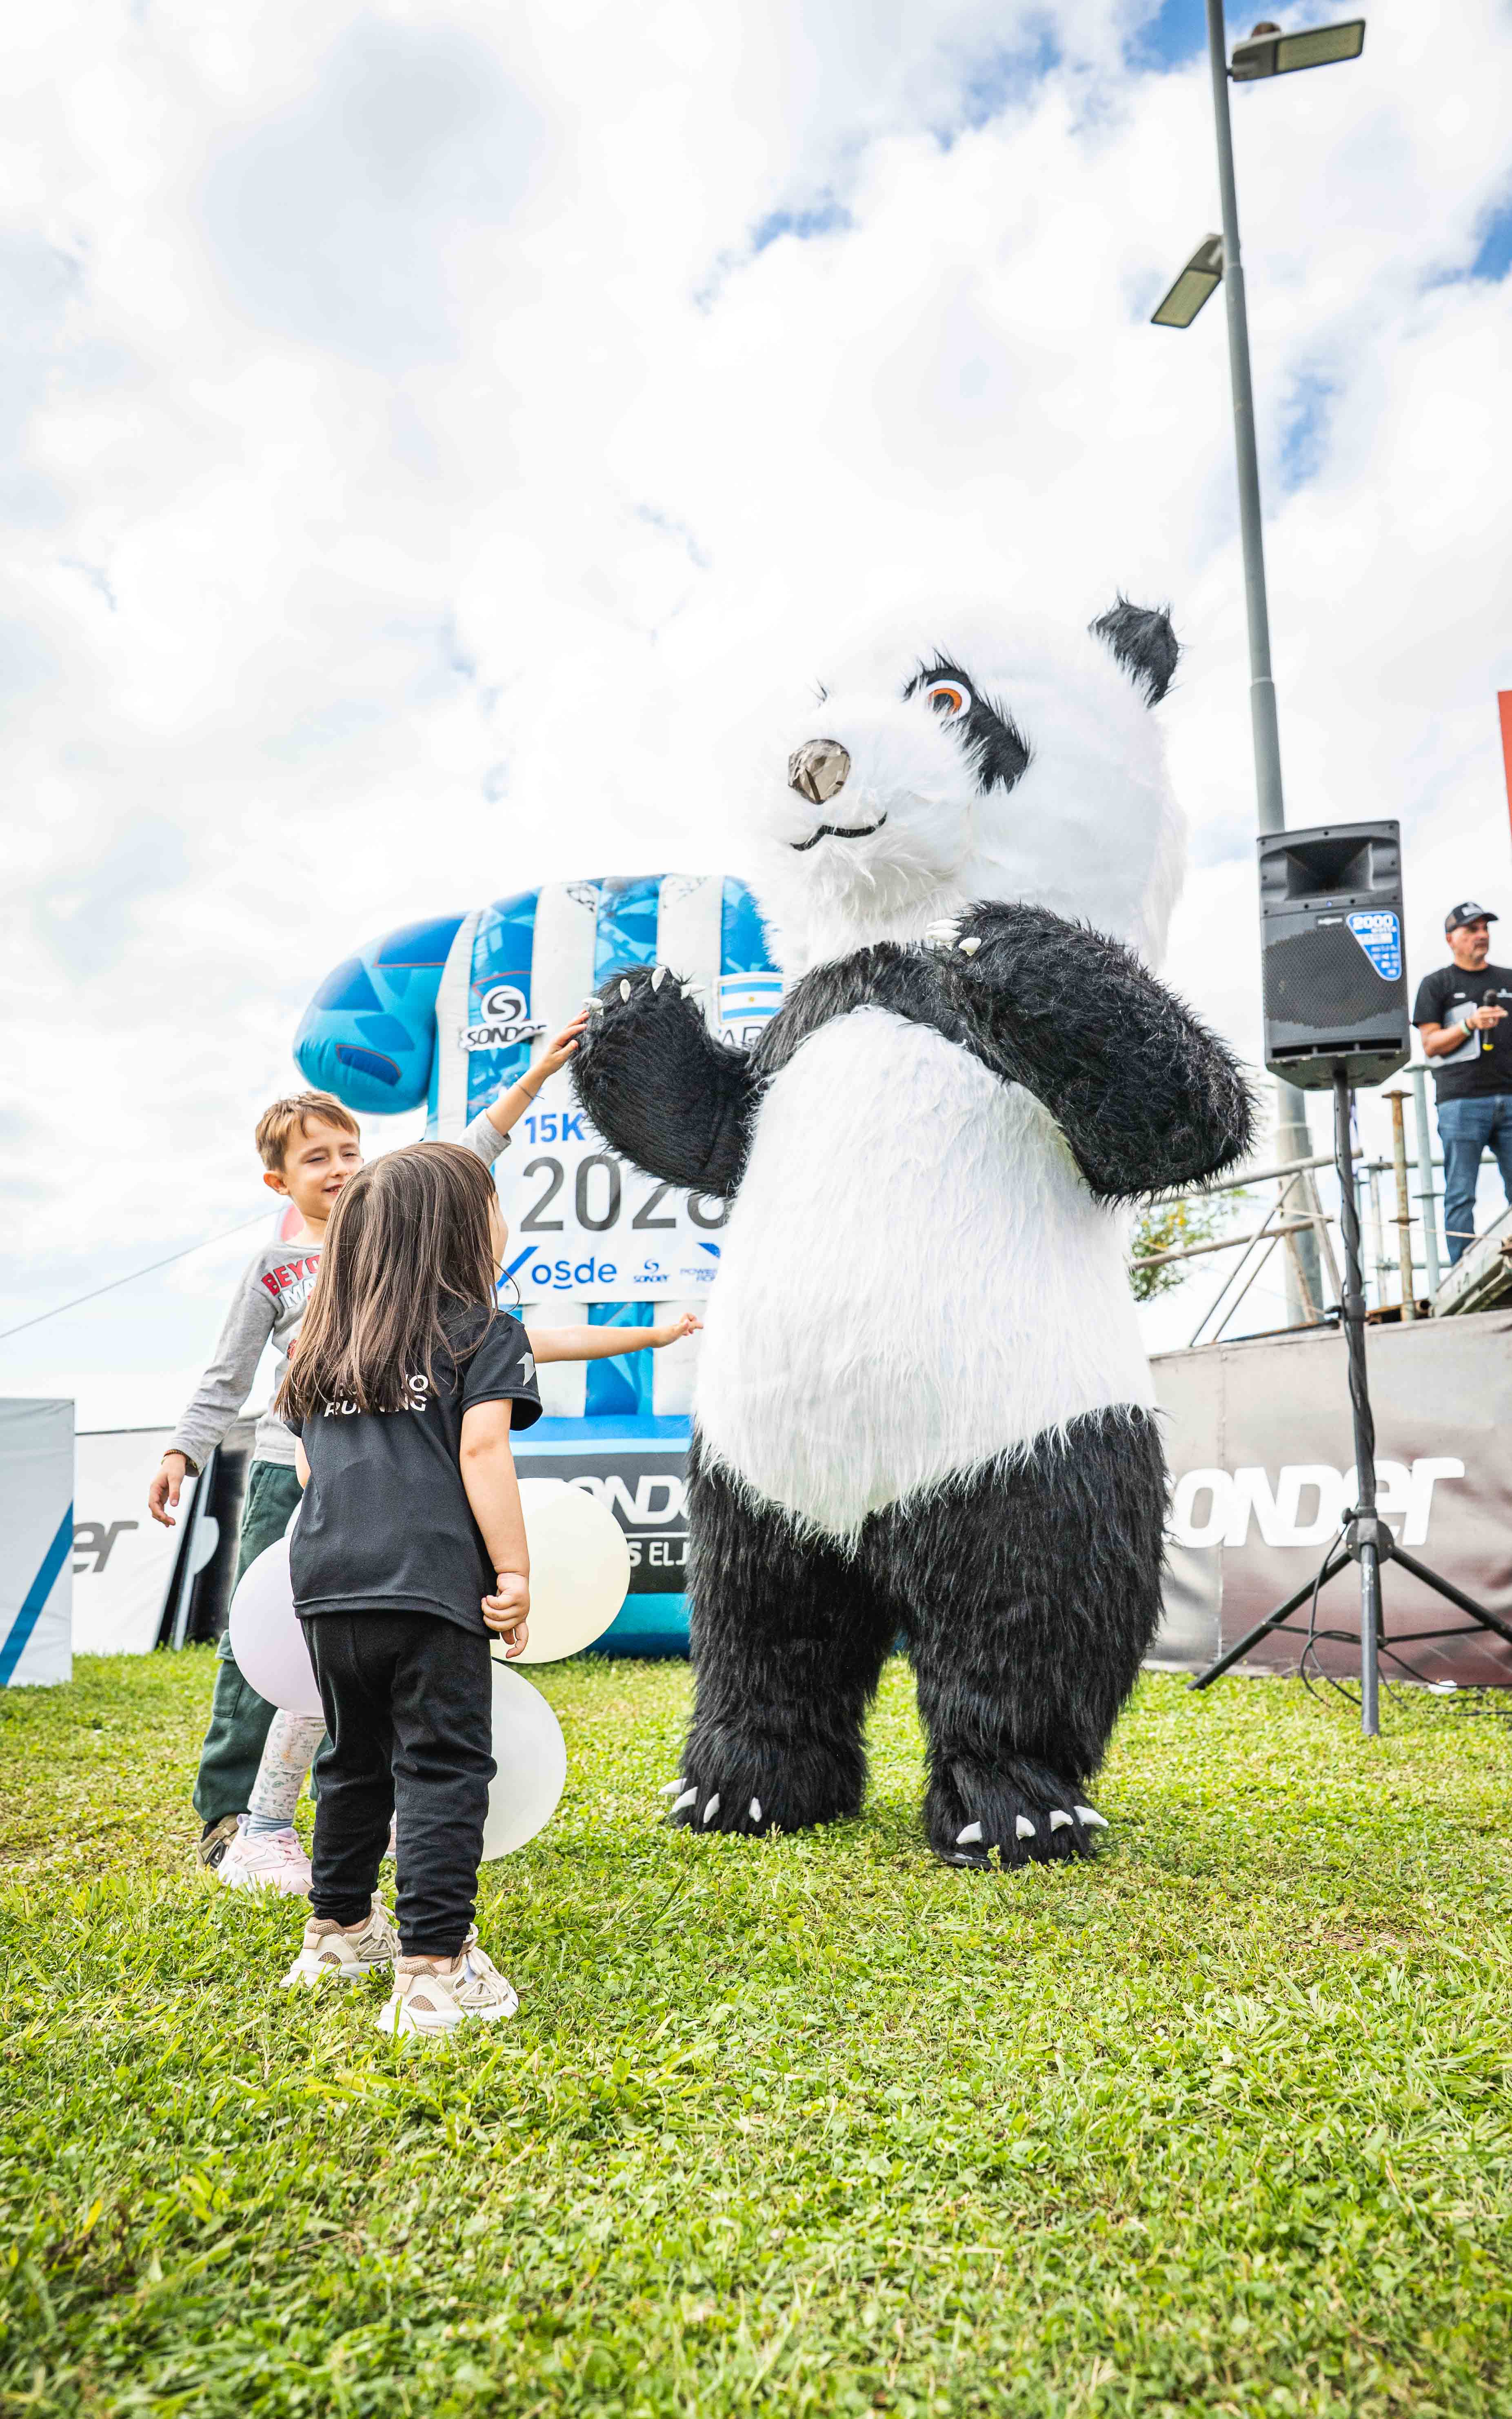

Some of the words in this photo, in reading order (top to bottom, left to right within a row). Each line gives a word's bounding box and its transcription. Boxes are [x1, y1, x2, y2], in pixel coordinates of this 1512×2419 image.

[524, 1113, 586, 1144] 15K
[532, 1257, 617, 1284] osde
[1161, 1456, 1465, 1548] ONDer
